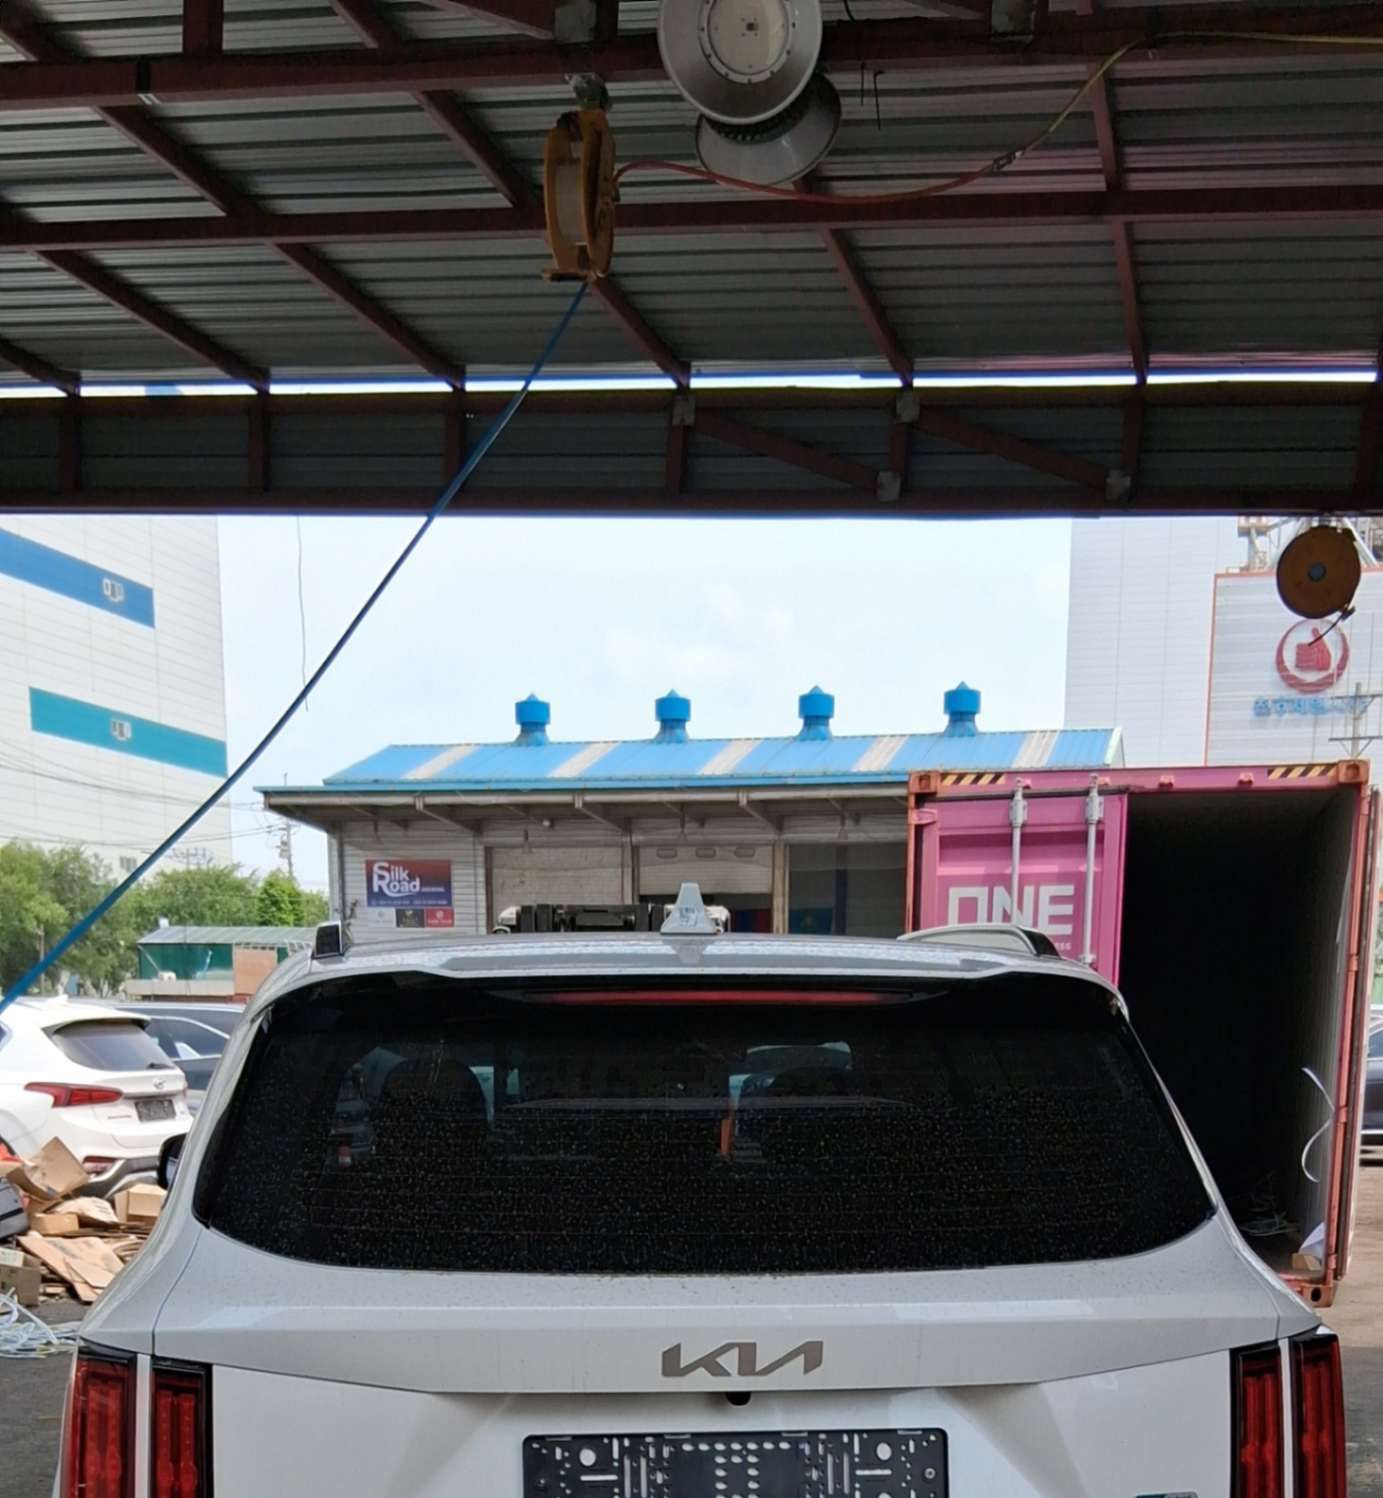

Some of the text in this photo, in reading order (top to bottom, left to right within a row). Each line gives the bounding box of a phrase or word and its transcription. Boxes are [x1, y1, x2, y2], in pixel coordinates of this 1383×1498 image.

[373, 862, 410, 881] Silk
[373, 873, 420, 897] Road
[948, 885, 1075, 935] ONE
[661, 1340, 824, 1378] KIA
